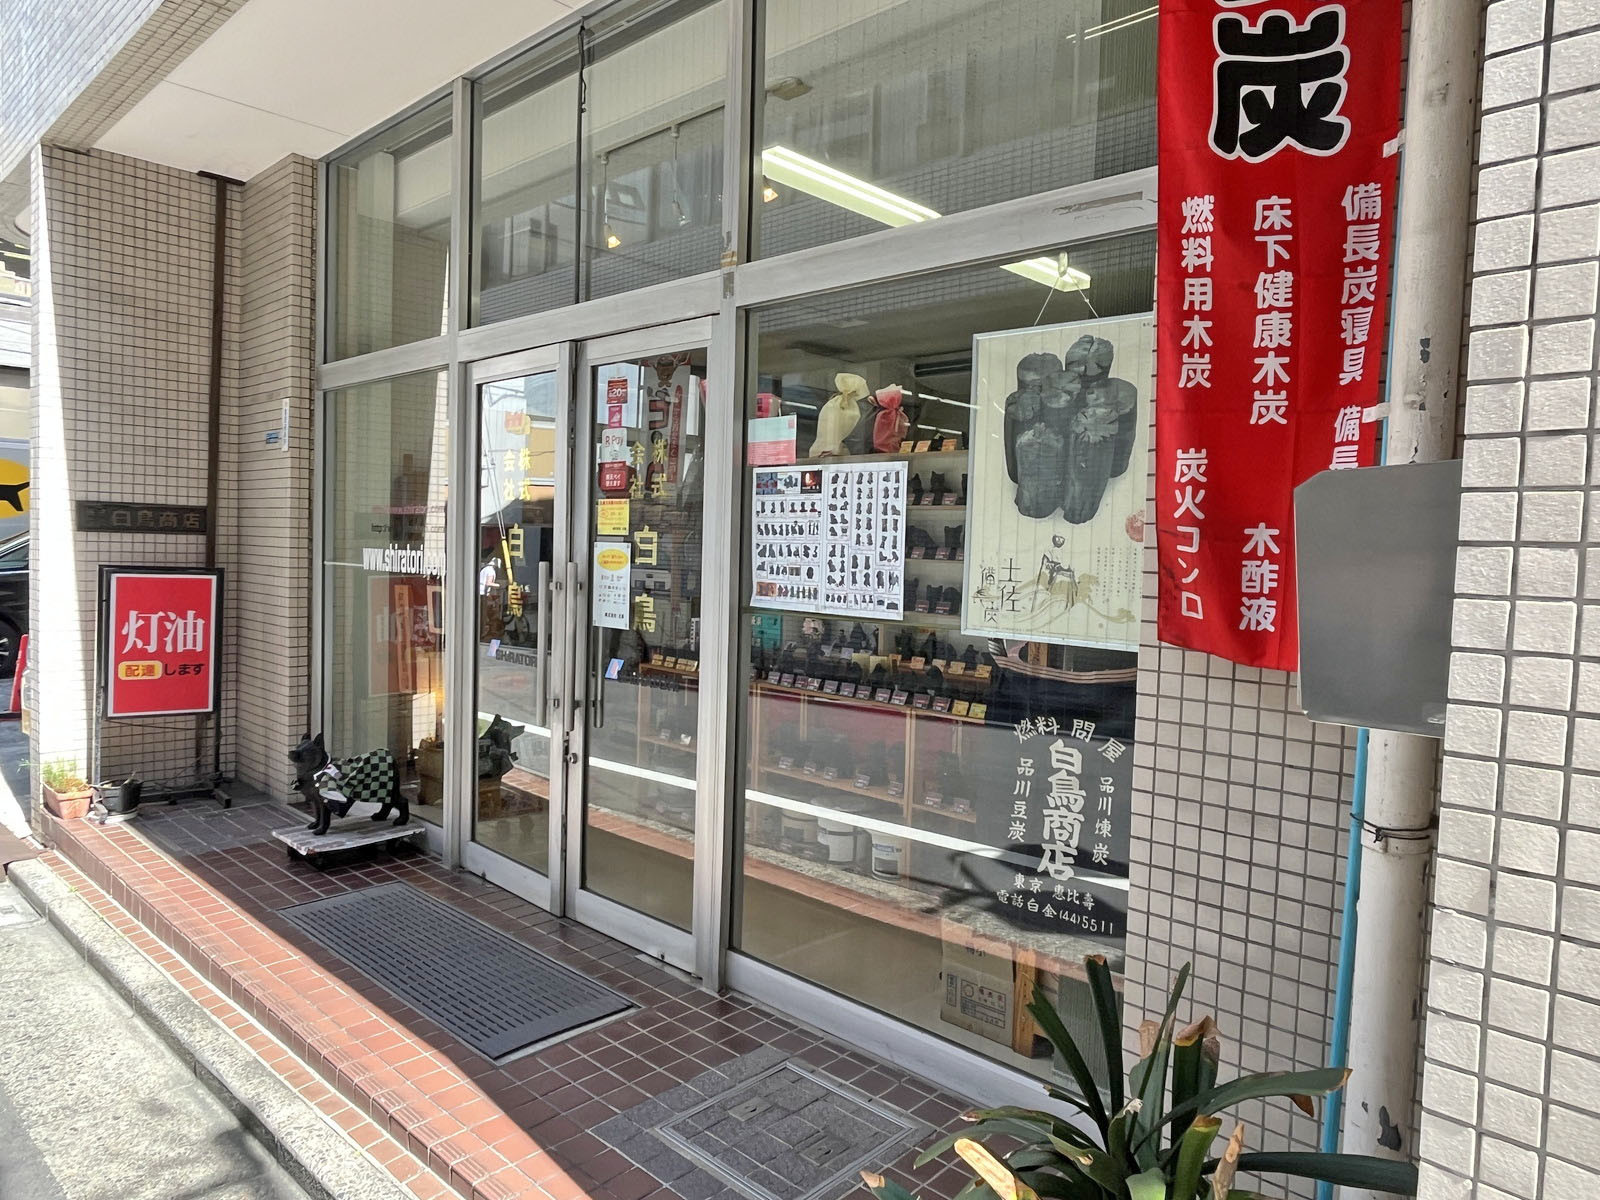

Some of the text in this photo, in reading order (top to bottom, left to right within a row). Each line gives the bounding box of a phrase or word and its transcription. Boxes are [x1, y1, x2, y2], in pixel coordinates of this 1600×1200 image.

[1208, 0, 1351, 164] 炭
[1178, 195, 1215, 389] 燃料用木炭
[1250, 195, 1293, 425] 床下健康木炭
[1339, 182, 1382, 386] 備長炭寝具
[998, 558, 1023, 612] 土佐
[1173, 447, 1209, 620] 炭火コンロ
[1239, 522, 1280, 633] 木酢液
[121, 610, 205, 654] 灯油
[1008, 757, 1035, 843] 品川豆炭
[1037, 738, 1087, 881] 白鳥商店
